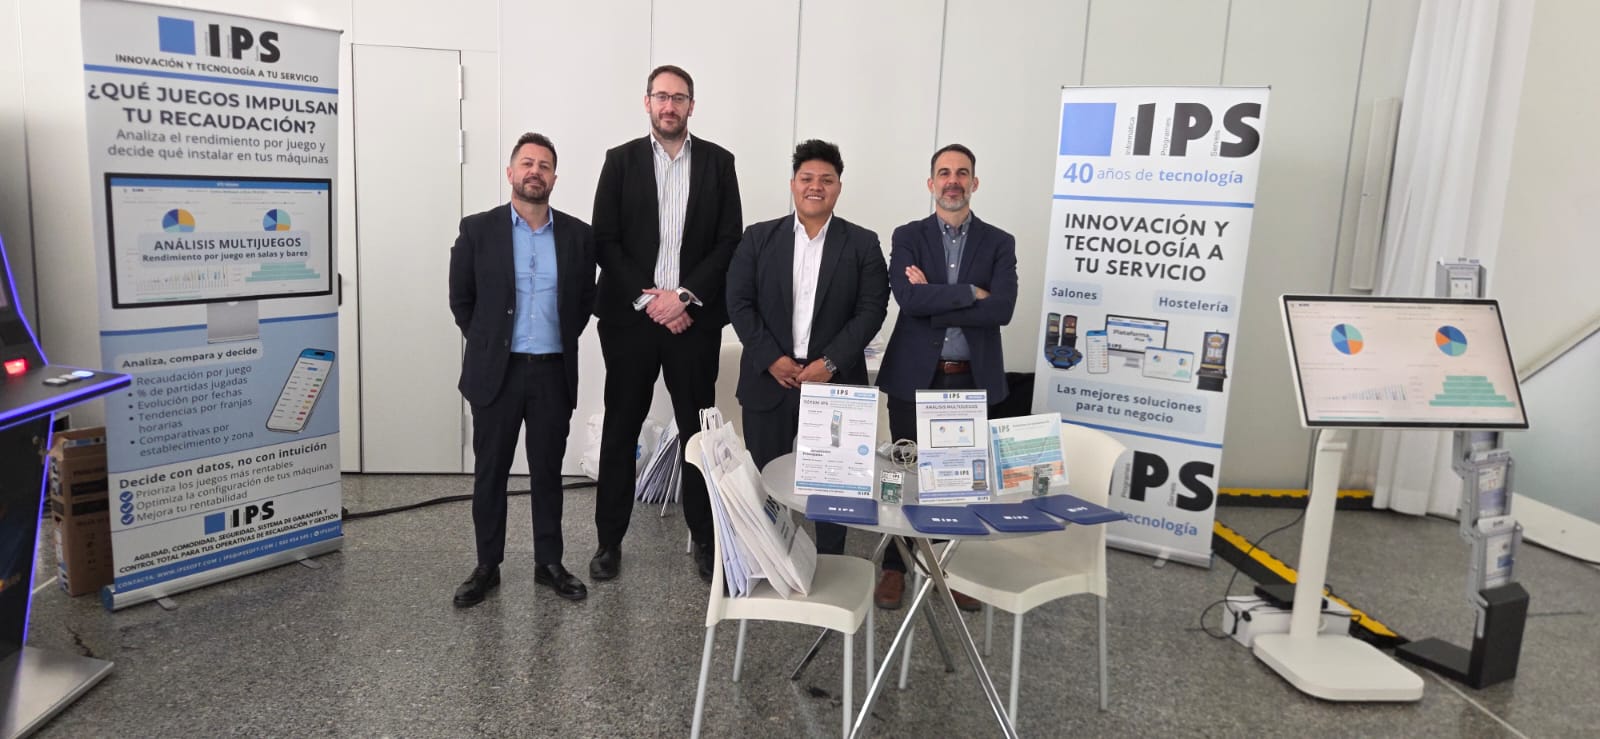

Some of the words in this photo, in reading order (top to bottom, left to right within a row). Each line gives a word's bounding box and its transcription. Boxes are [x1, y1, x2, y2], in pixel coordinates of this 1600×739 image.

[209, 24, 280, 63] IPS
[115, 54, 184, 69] INNOVACIÓN
[196, 63, 255, 77] TECNOLOGÍA
[267, 70, 278, 79] TU
[280, 72, 319, 83] SERVICIO
[88, 82, 150, 101] ¿QUÉ
[157, 87, 240, 108] JUEGOS
[246, 95, 338, 115] IMPULSAN
[123, 107, 152, 123] TU
[160, 109, 316, 134] RECAUDACIÓN?
[1132, 102, 1262, 158] IPS
[116, 129, 166, 142] Analiza
[170, 131, 181, 143] el
[186, 133, 260, 147] rendimiento
[264, 138, 283, 151] por
[286, 138, 317, 152] juego
[320, 142, 326, 153] y
[108, 144, 154, 158] decide
[158, 144, 184, 161] qué
[188, 147, 233, 161] instalar
[237, 152, 252, 162] en
[255, 151, 273, 163] tus
[276, 150, 329, 166] máquinas
[1063, 162, 1094, 184] 40
[1097, 167, 1131, 181] años
[1135, 168, 1153, 182] de
[1159, 169, 1243, 187] tecnología
[1064, 213, 1206, 236] INNOVACIÓN
[1214, 221, 1230, 238] Y
[142, 253, 202, 263] Rendimiento
[204, 253, 218, 262] por
[220, 251, 243, 262] juego
[257, 251, 277, 259] salas
[286, 249, 308, 257] bares
[154, 237, 215, 251] ANÁLISIS
[219, 237, 302, 250] MULTIJUEGOS
[1064, 234, 1201, 260] TECNOLOGÍA
[1207, 244, 1224, 261] A
[1075, 257, 1099, 274] TU
[1105, 259, 1206, 283] SERVICIO
[1051, 287, 1098, 301] Salones
[1159, 297, 1229, 313] Hostelería
[122, 357, 167, 368] Analiza,
[169, 352, 215, 364] compara
[216, 351, 223, 360] y
[225, 346, 258, 358] decide
[136, 370, 204, 386] Recaudación
[206, 368, 224, 379] por
[225, 365, 252, 377] juego
[136, 389, 147, 398] %
[150, 387, 163, 397] de
[166, 382, 209, 396] partidas
[211, 377, 248, 390] jugadas
[137, 396, 189, 411] Evolución
[191, 394, 206, 406] por
[207, 388, 243, 402] fechas
[138, 406, 198, 422] Tendencias
[200, 403, 217, 416] por
[219, 397, 253, 412] franjas
[1057, 384, 1077, 395] Las
[1080, 388, 1130, 403] mejores
[1133, 395, 1202, 414] soluciones
[1076, 400, 1104, 413] para
[1107, 405, 1121, 416] tu
[1124, 409, 1174, 424] negocio
[138, 420, 183, 434] horarias
[139, 427, 211, 446] Comparativas
[213, 424, 230, 436] por
[140, 436, 222, 457] establecimiento
[224, 437, 230, 446] y
[231, 431, 254, 442] zona
[119, 473, 167, 490] Decide
[170, 468, 193, 480] con
[196, 460, 234, 477] datos,
[237, 457, 253, 467] no
[255, 453, 276, 464] con
[278, 442, 328, 460] intuición
[136, 484, 177, 499] Prioriza
[179, 480, 194, 491] los
[195, 474, 229, 489] juegos
[230, 469, 250, 481] más
[252, 460, 294, 475] rentables
[136, 494, 184, 512] Optimiza
[186, 490, 195, 501] la
[197, 477, 261, 498] configuración
[263, 472, 275, 483] de
[277, 470, 291, 480] tus
[292, 462, 334, 479] máquinas
[1108, 450, 1214, 512] PS
[136, 506, 174, 523] Mejora
[176, 502, 187, 513] tu
[189, 490, 248, 510] rentabilidad
[232, 500, 275, 528] IPS
[119, 561, 155, 574] CONTROL
[157, 554, 179, 564] TOTAL
[181, 548, 201, 558] PARA
[201, 544, 214, 553] TUS
[215, 535, 256, 550] OPERATIVAS
[264, 520, 308, 537] RECAUDACIÓN
[314, 513, 339, 524] GESTIÓN
[134, 548, 171, 562] AGILIDAD,
[171, 536, 217, 552] COMODIDAD,
[218, 527, 256, 541] SEGURIDAD,
[257, 520, 283, 531] SISTEMA
[292, 509, 323, 522] GARANTÍA
